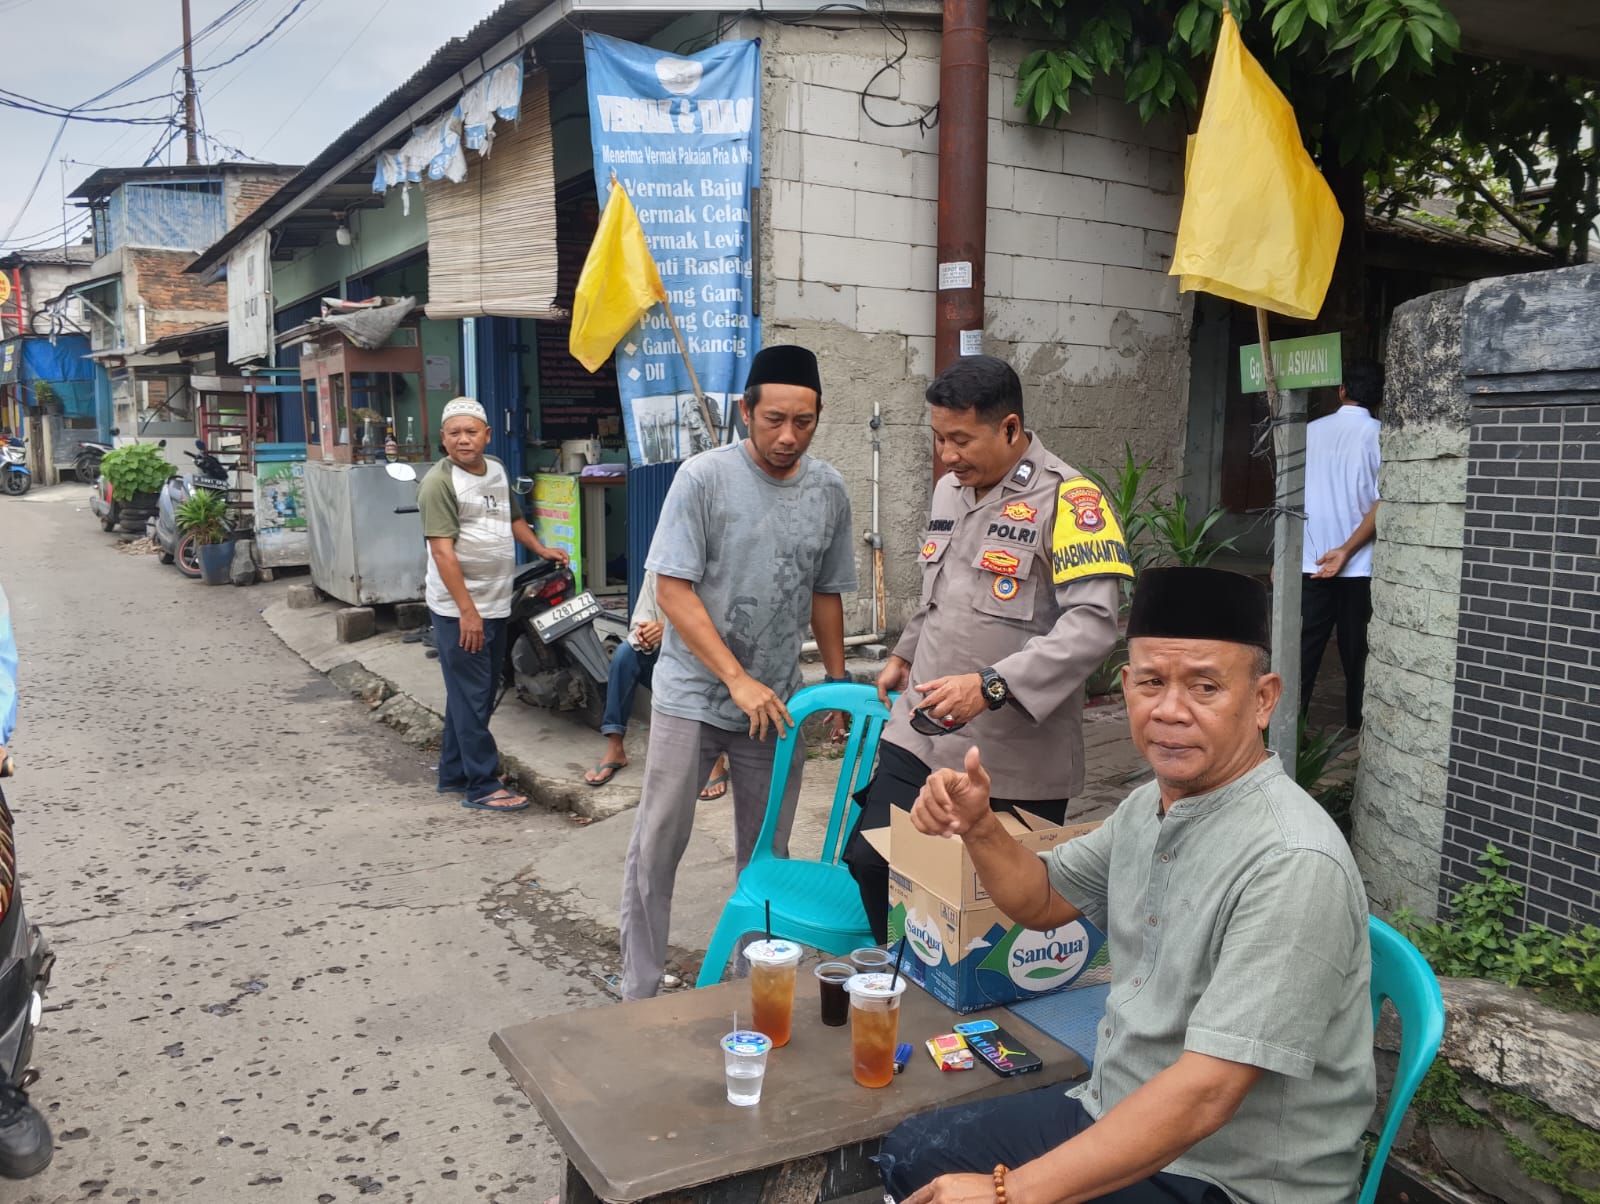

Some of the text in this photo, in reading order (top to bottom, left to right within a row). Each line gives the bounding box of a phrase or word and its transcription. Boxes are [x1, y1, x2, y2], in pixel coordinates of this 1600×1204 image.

[597, 95, 675, 134] VERMAK
[678, 98, 696, 134] &
[602, 145, 644, 164] Menerima
[645, 145, 678, 165] Vermak
[679, 146, 712, 165] Pakaian
[713, 148, 729, 165] Pria
[624, 178, 743, 200] Vermak Baju
[644, 231, 699, 250] ermak
[657, 257, 678, 276] nti
[640, 311, 698, 333] Potong
[645, 363, 664, 381] Dll
[1249, 356, 1262, 385] Gg.
[1287, 348, 1328, 376] ASWANI
[987, 523, 1037, 544] POLRI
[906, 918, 941, 952] SanQua
[1012, 939, 1084, 968] SanQua
[968, 1035, 1014, 1068] JORDAN
